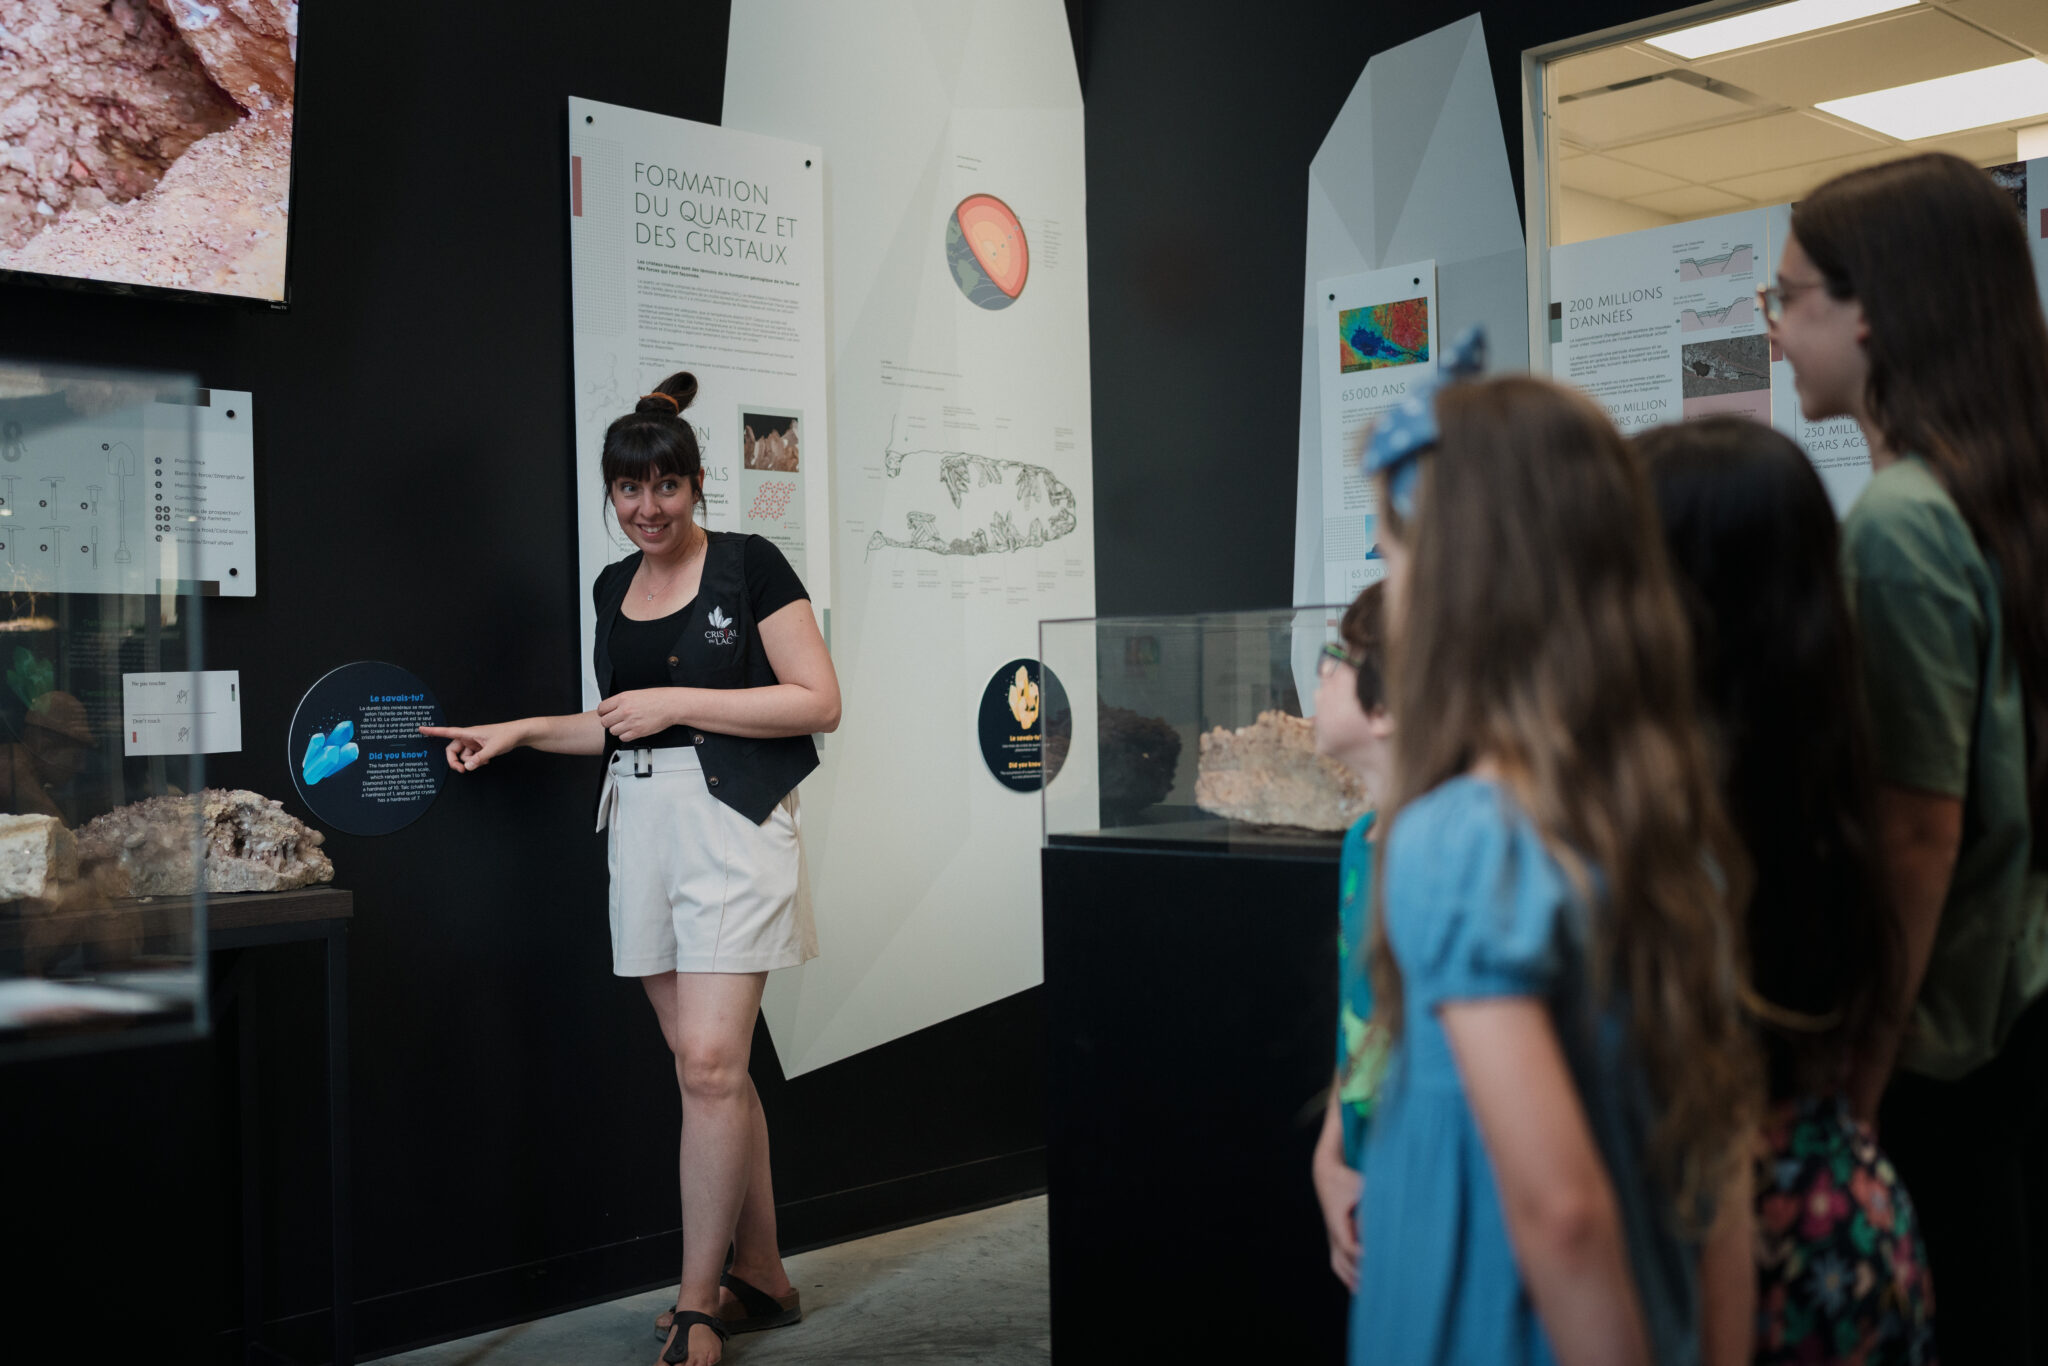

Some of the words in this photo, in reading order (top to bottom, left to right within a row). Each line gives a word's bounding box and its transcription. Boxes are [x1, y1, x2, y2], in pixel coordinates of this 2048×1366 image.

[635, 162, 768, 205] FORMATION
[636, 192, 668, 217] DU
[680, 200, 767, 233] QUARTZ
[777, 216, 797, 237] ET
[636, 222, 676, 248] DES
[686, 231, 787, 265] CRISTAUX
[1570, 297, 1593, 312] 200
[1599, 287, 1663, 307] MILLIONS
[1382, 382, 1406, 395] ANS
[1624, 400, 1667, 412] MILLION
[1635, 413, 1658, 424] AGO
[1805, 427, 1824, 438] 250
[1829, 424, 1862, 435] MILLI
[1804, 439, 1838, 452] YEARS
[705, 628, 740, 638] CRISTAL
[715, 637, 733, 645] LAC
[382, 694, 424, 702] savais-tu?
[369, 752, 382, 760] Did
[402, 750, 428, 759] know?
